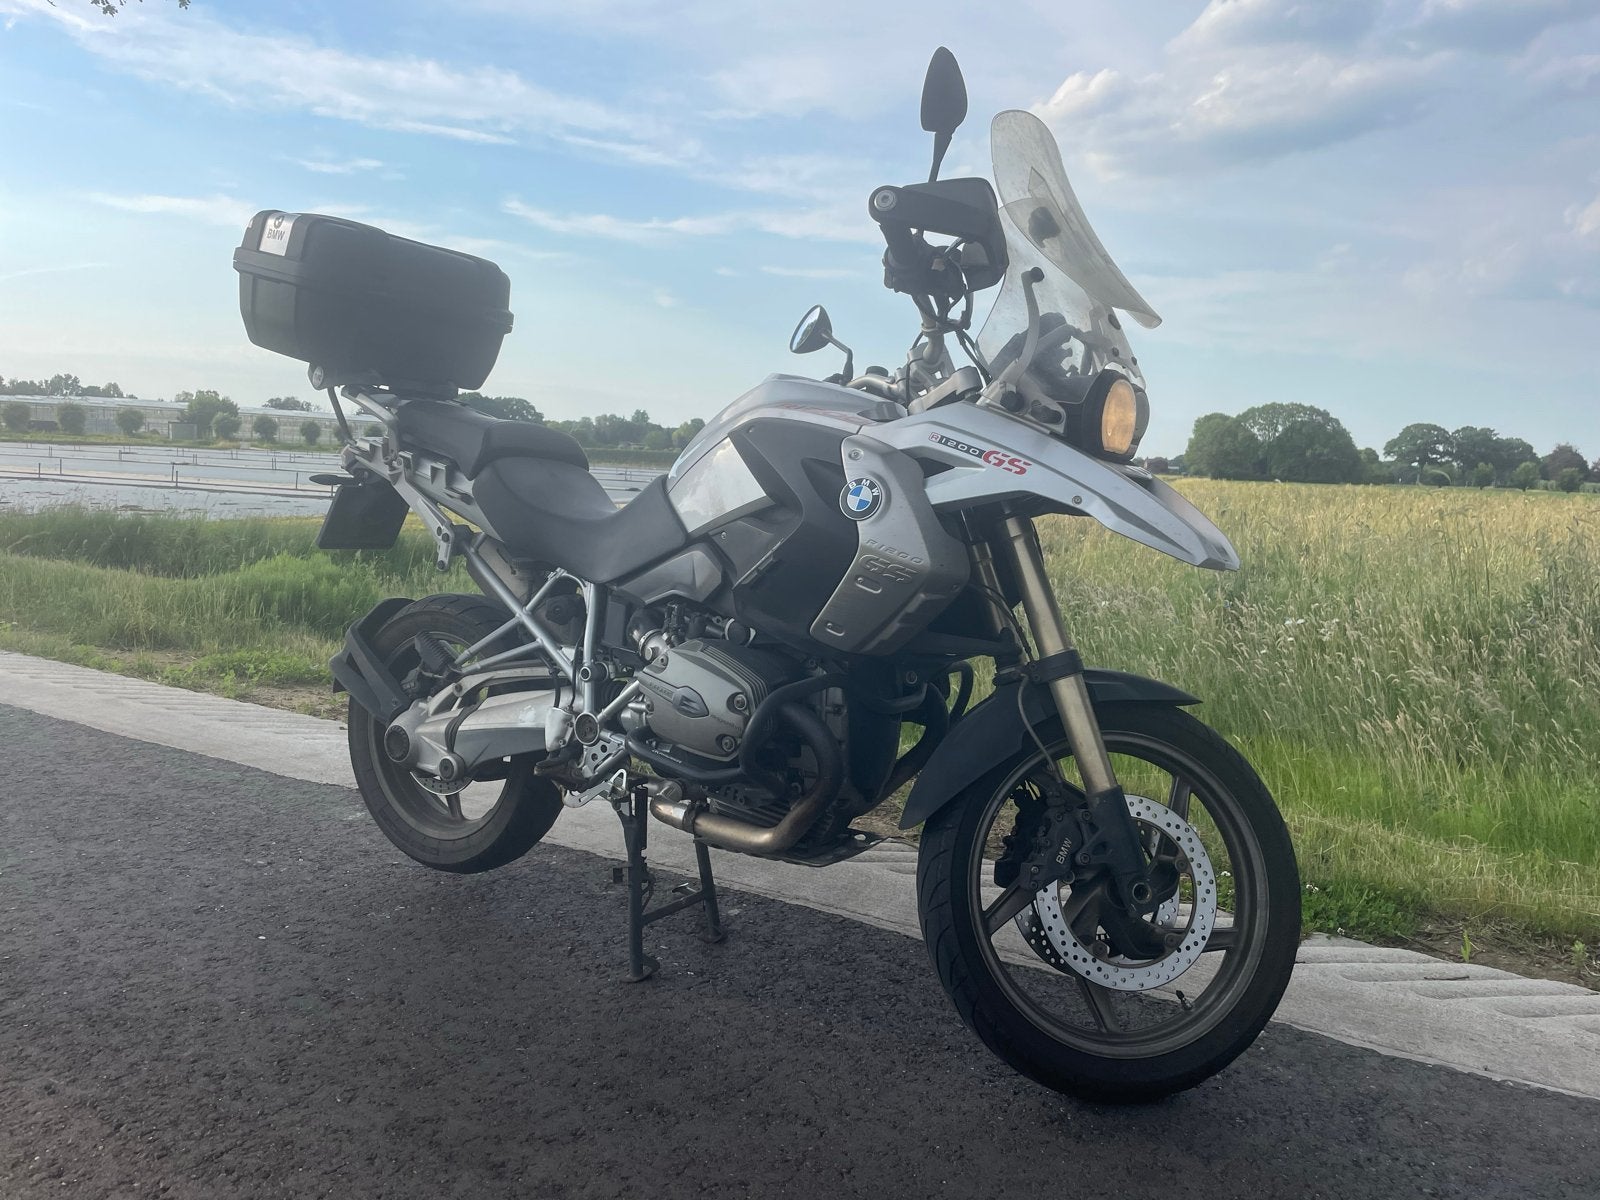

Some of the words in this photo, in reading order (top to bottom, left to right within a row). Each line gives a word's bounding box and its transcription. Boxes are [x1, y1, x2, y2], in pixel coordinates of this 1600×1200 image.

[266, 228, 286, 241] BMW
[982, 450, 1033, 475] GS
[848, 478, 880, 496] BMW
[859, 554, 920, 584] GS
[1055, 837, 1072, 865] BMW
